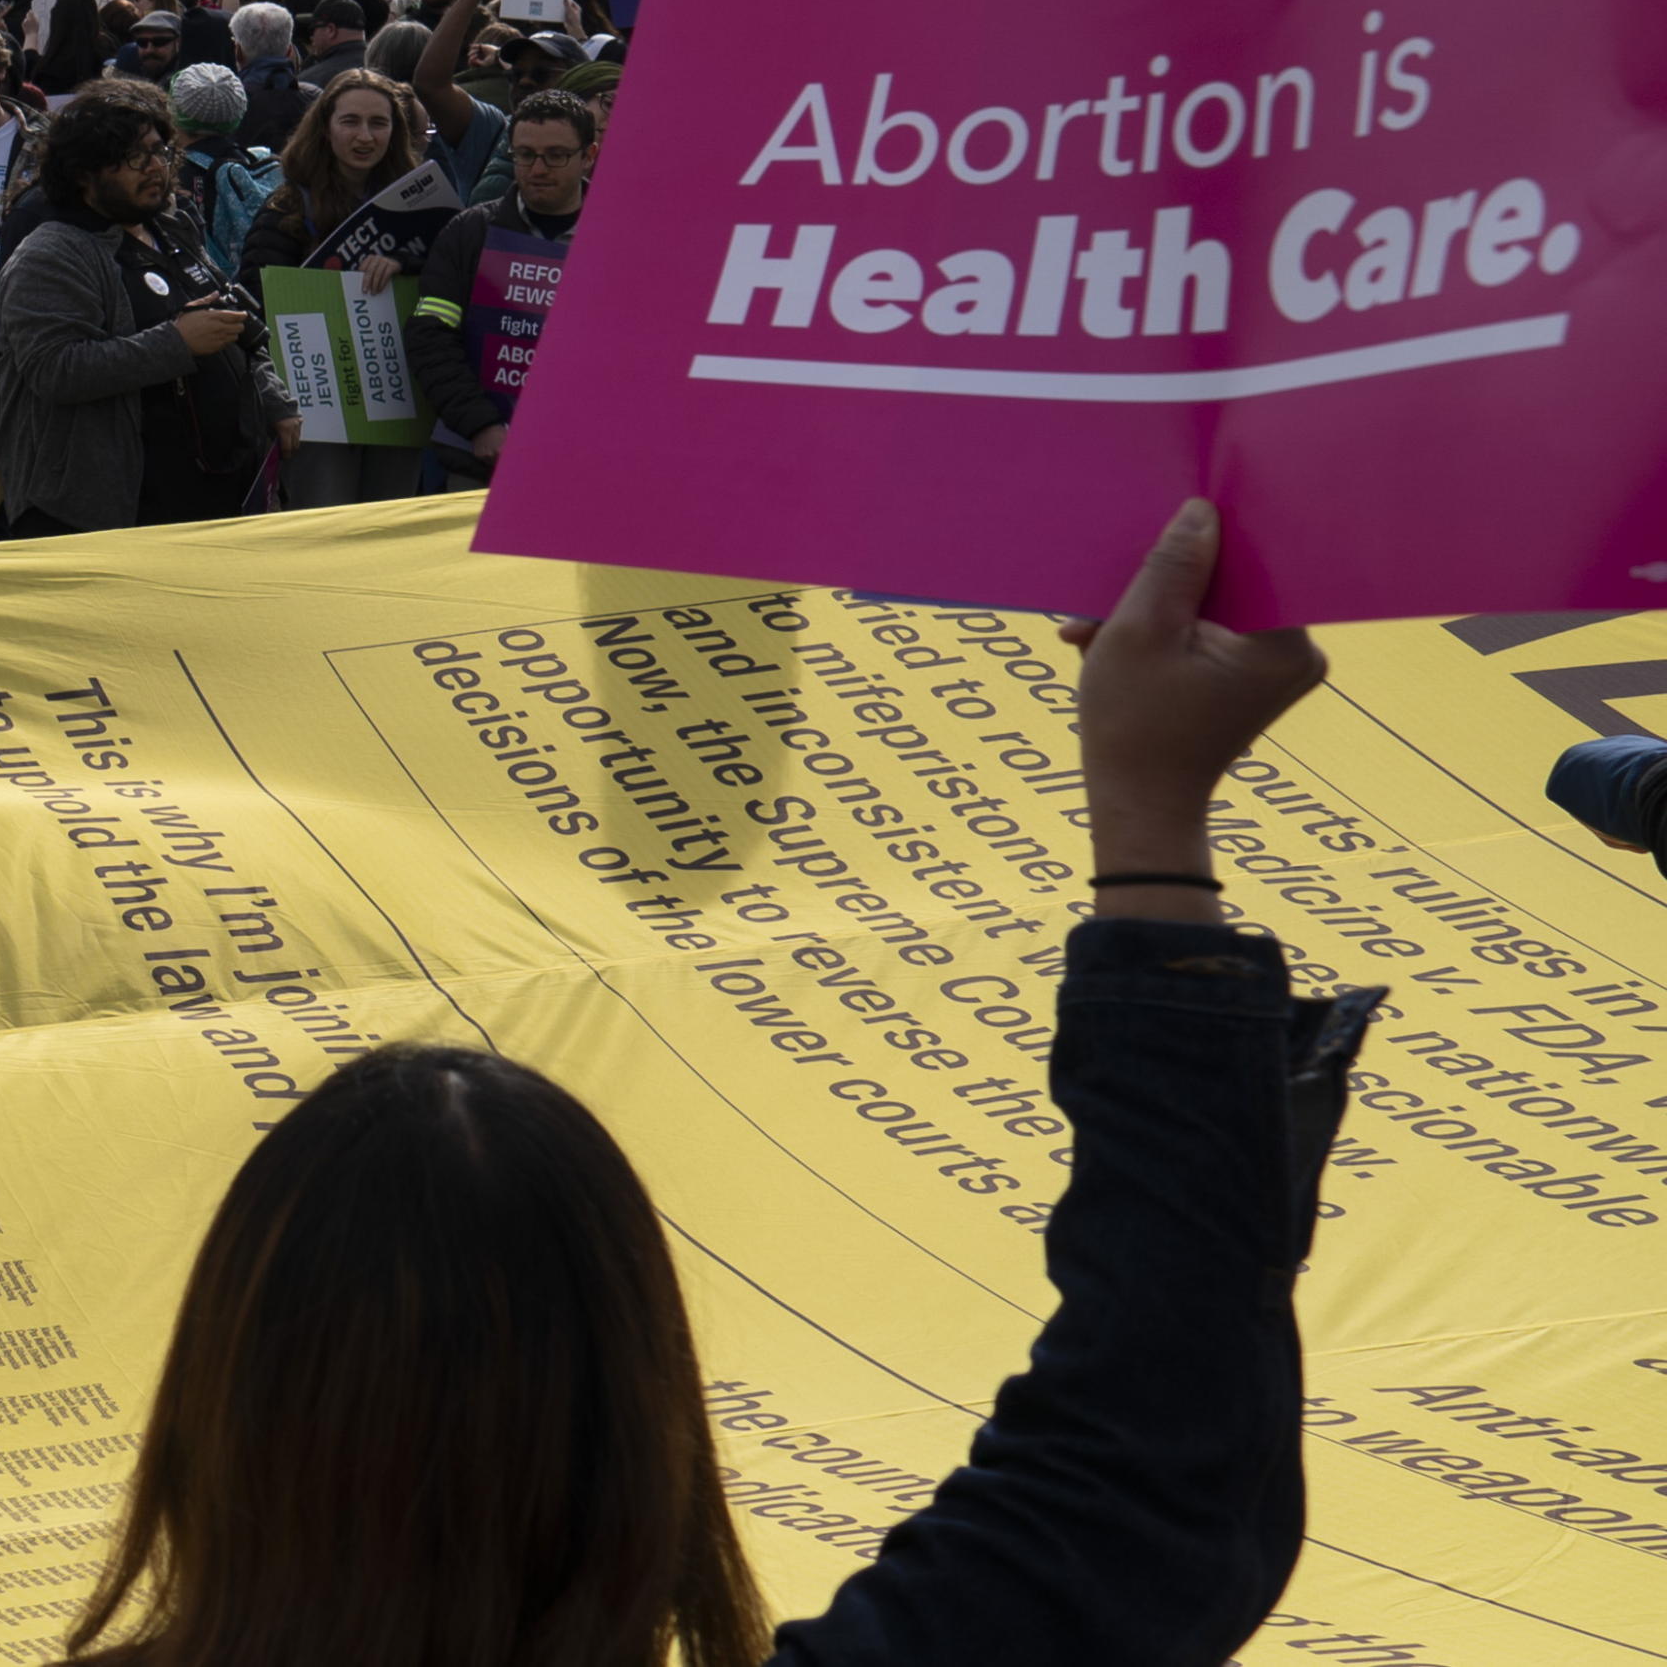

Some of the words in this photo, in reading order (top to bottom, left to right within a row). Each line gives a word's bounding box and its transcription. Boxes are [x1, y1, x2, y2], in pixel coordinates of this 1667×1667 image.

[737, 55, 1315, 187] Abortion
[1353, 9, 1433, 137] is
[400, 173, 434, 201] ncjw
[706, 205, 1232, 339] Health
[1268, 178, 1580, 322] Care.
[285, 321, 313, 408] REFORM
[312, 352, 334, 408] JEWS
[354, 298, 385, 404] ABORTION
[378, 321, 406, 402] ACCESS
[500, 315, 539, 336] fight
[663, 607, 780, 679] and
[742, 685, 1044, 940] inconsistent
[790, 640, 1074, 896] mifepristone,
[931, 678, 997, 720] to
[44, 678, 132, 771] This
[105, 779, 163, 799] is
[140, 804, 234, 873] why
[204, 885, 284, 953] I'm
[579, 616, 690, 715] Now,
[676, 718, 764, 787] the
[744, 794, 954, 968] Supreme
[96, 859, 173, 934] the
[143, 949, 231, 1021] law
[413, 640, 600, 836] decisions
[578, 845, 670, 886] of
[625, 895, 718, 951] the
[695, 957, 854, 1068] lower
[829, 1077, 1021, 1196] courts
[497, 628, 743, 874] opportunity
[720, 883, 790, 927] to
[771, 930, 969, 1072] reverse
[953, 1075, 1065, 1139] the
[1369, 866, 1588, 981] rulings
[1569, 980, 1660, 1018] in
[1410, 966, 1483, 995] v.
[1468, 1003, 1653, 1086] FDA,
